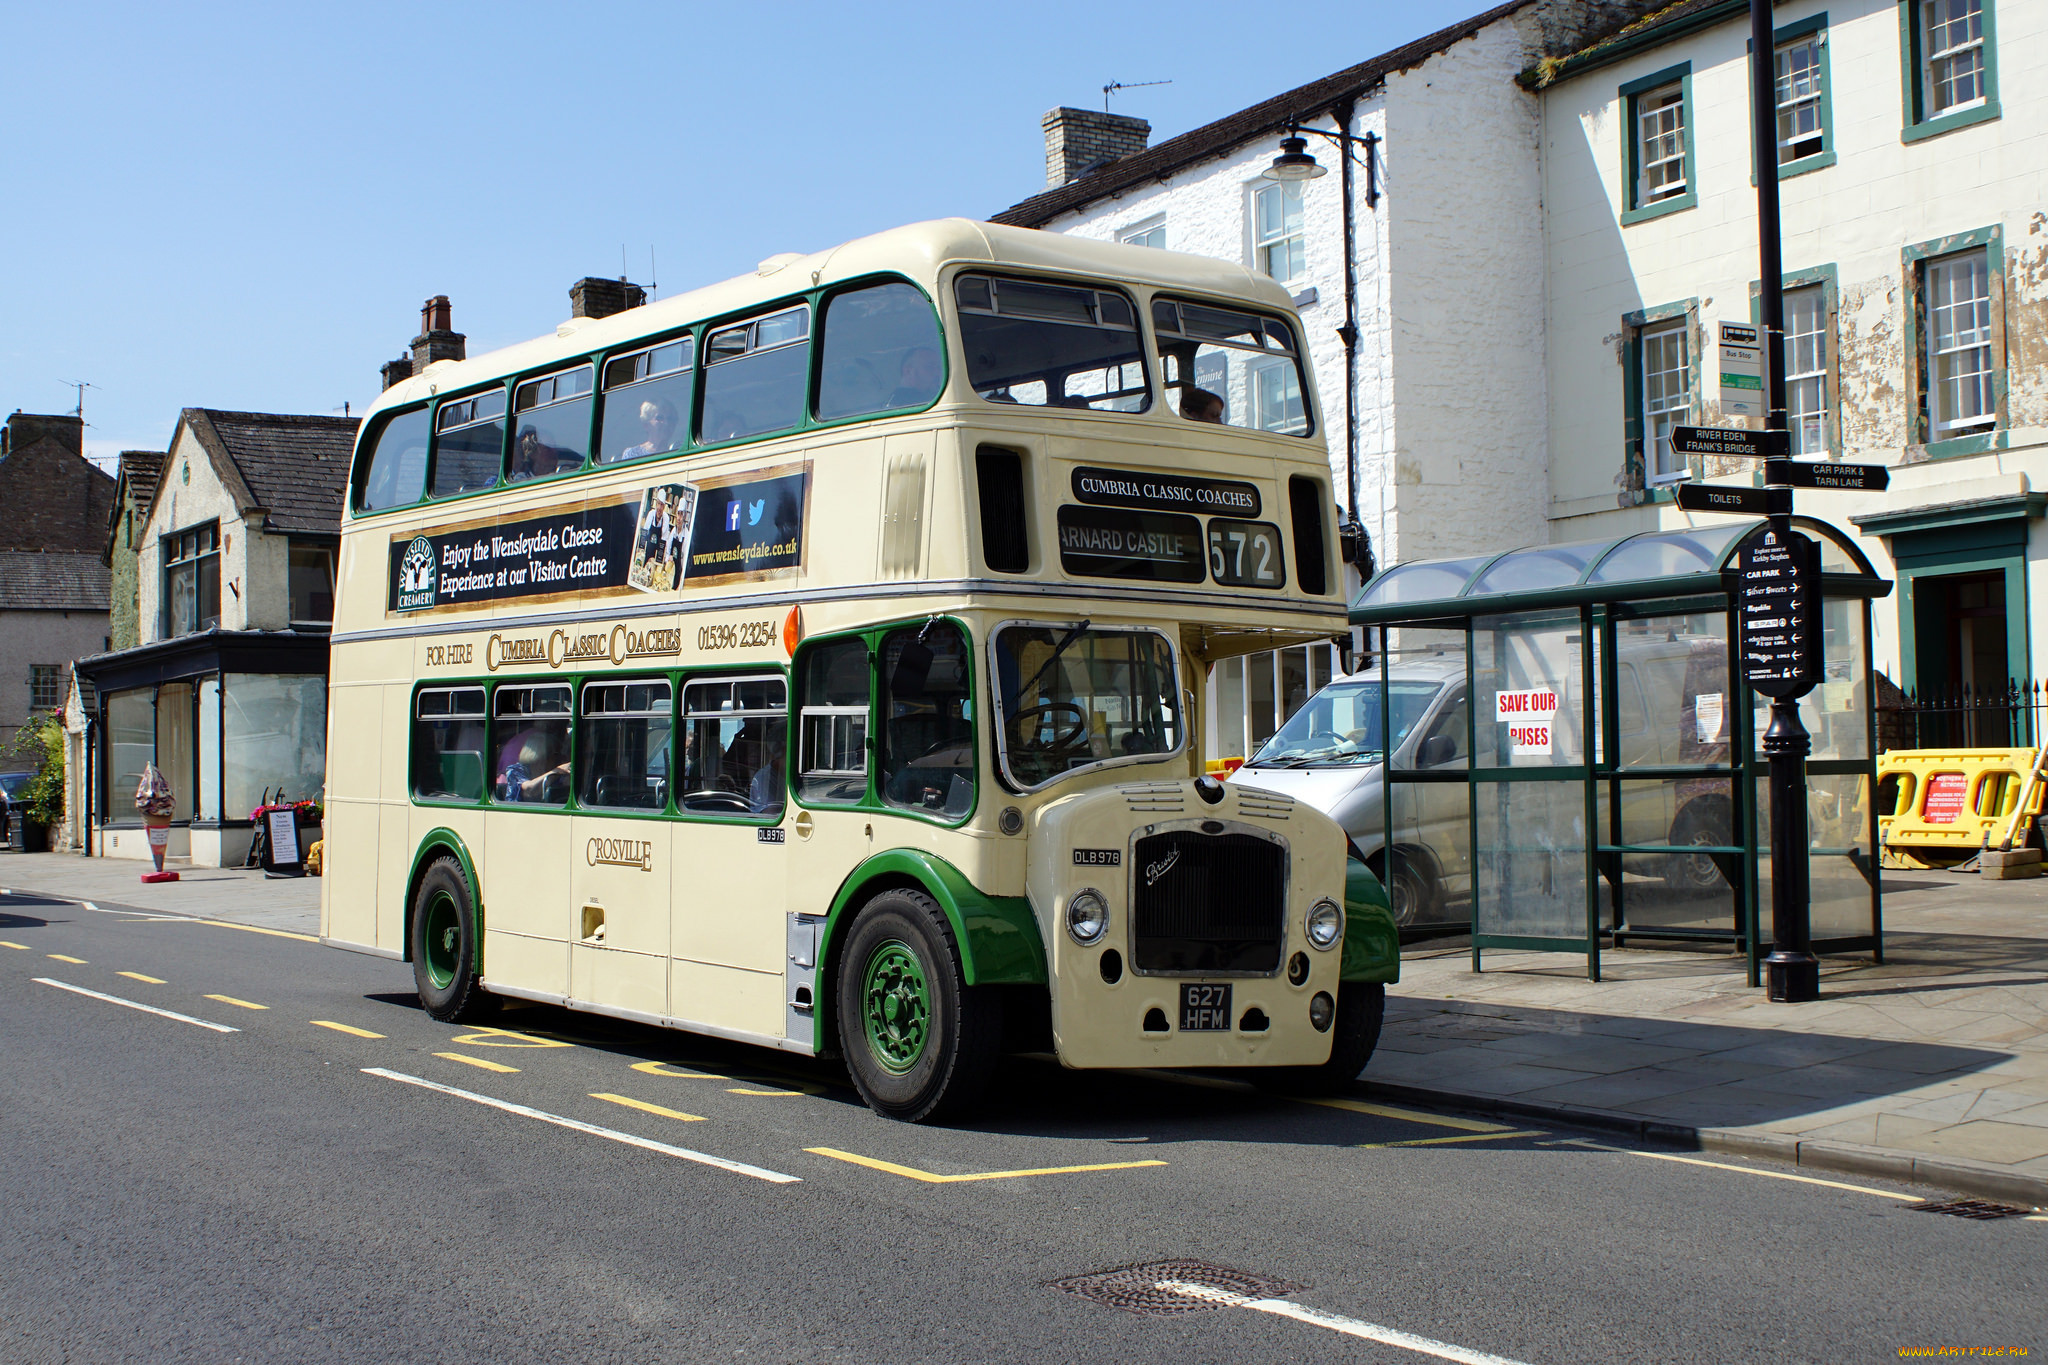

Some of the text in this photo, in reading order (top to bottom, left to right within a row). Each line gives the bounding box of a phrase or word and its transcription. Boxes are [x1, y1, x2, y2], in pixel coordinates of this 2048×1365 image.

[1738, 352, 1752, 360] Stop
[1196, 369, 1223, 385] ennine
[1696, 430, 1746, 442] RIVER EDEN
[1686, 441, 1757, 454] FRANK'S BRIDGE
[1812, 464, 1865, 476] CAR PARK &
[1815, 476, 1864, 488] TARN LANE
[1080, 477, 1254, 508] CUMBRIA CLASSIC COACHES
[1708, 493, 1742, 505] TOILETS
[442, 525, 603, 570] Enjoy the Wensleydale Cheese
[692, 537, 798, 566] www.wensleydale.co.uk
[1061, 526, 1185, 557] ARNARD CASTLE
[1210, 531, 1275, 580] 572
[1752, 553, 1790, 563] Kirkby Stephen
[440, 555, 607, 598] Experience at our Visitor Centre
[1746, 569, 1781, 579] CAR PARK
[400, 591, 434, 607] CREAMERY
[698, 620, 778, 651] 015396 23254
[426, 643, 473, 666] FOR HIRE
[1500, 692, 1556, 712] SAVE OUR
[758, 829, 785, 841] DLB978
[586, 837, 652, 872] CROSVILLE
[1074, 851, 1120, 864] DLB978
[1146, 842, 1180, 886] Bristol
[1188, 986, 1225, 1007] 627
[1186, 1009, 1224, 1029] HFM
